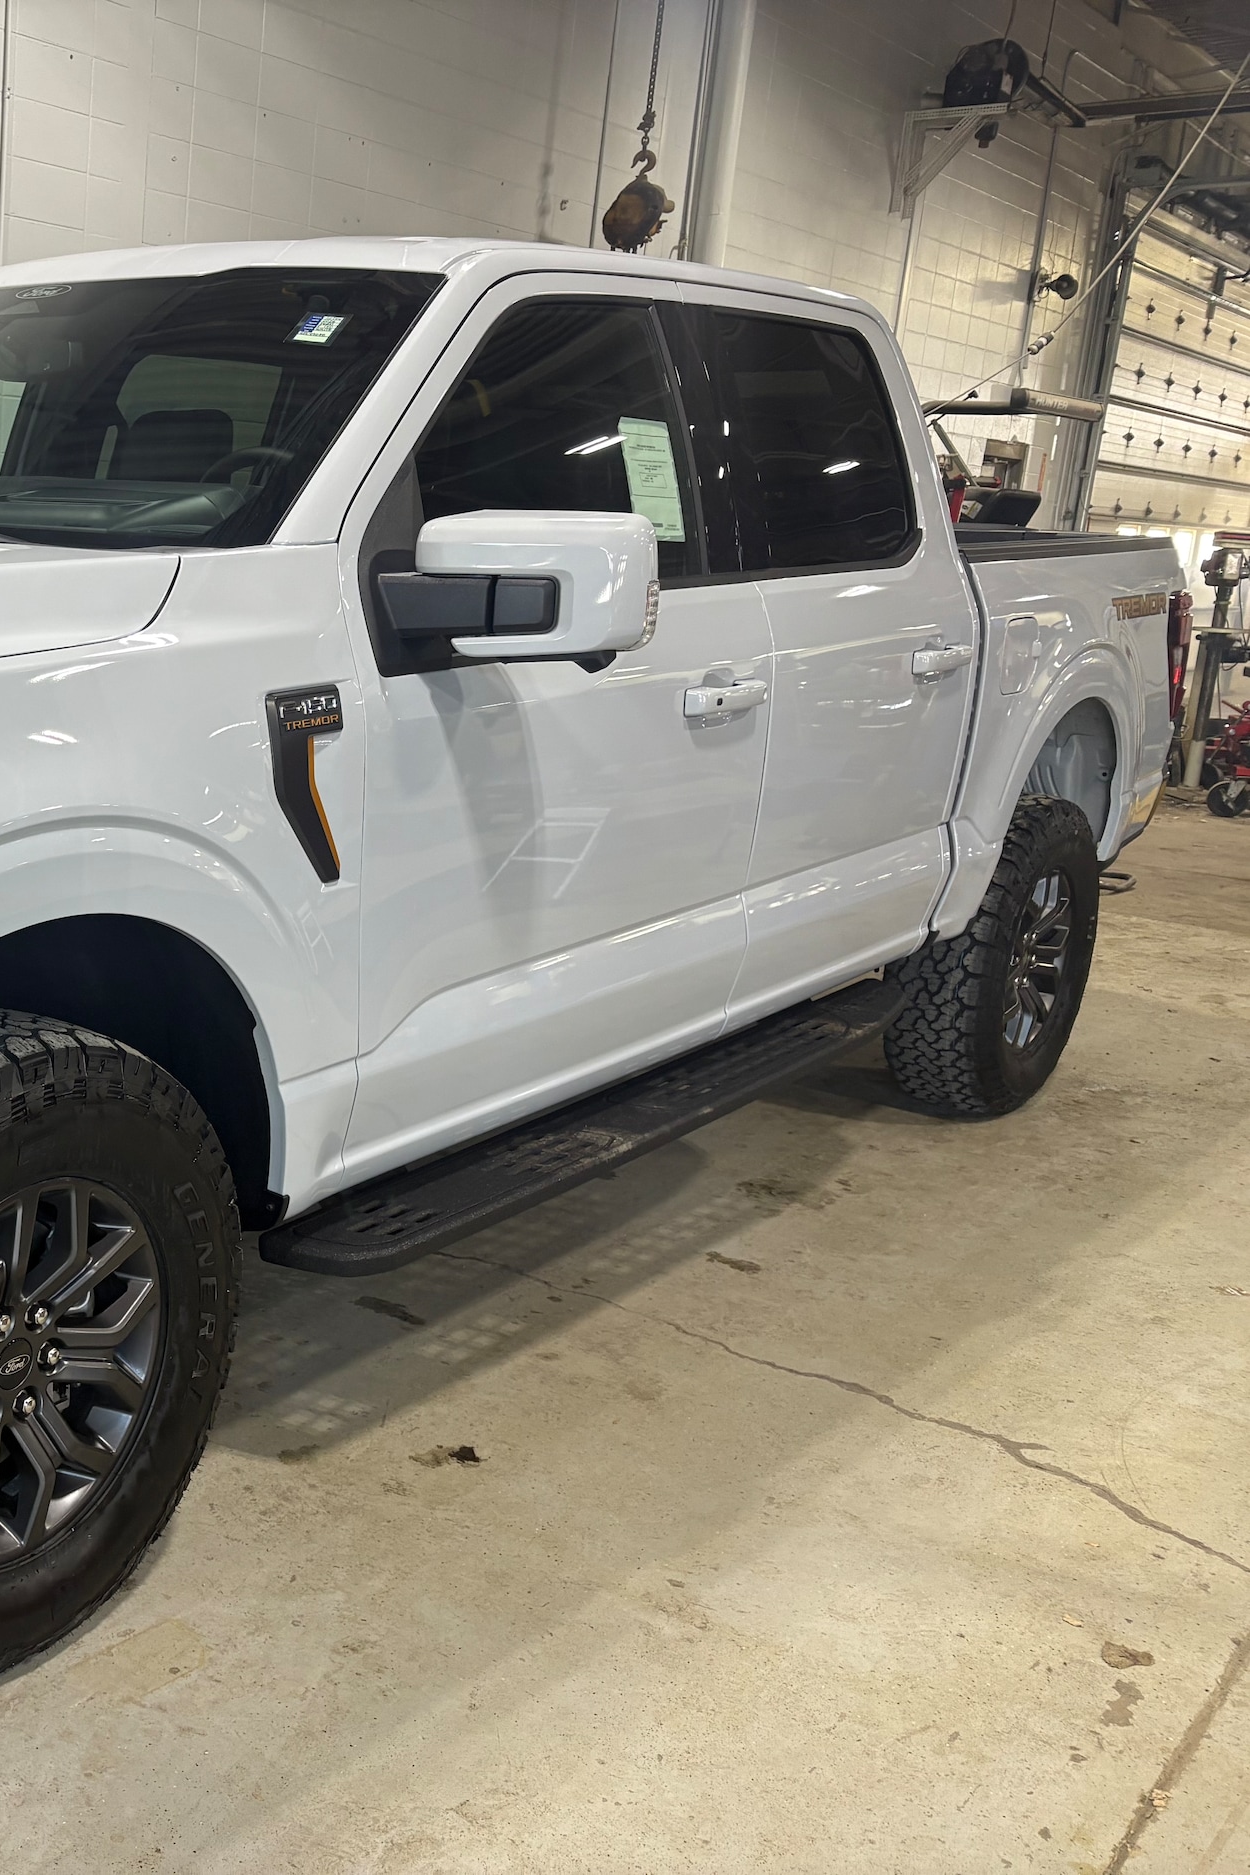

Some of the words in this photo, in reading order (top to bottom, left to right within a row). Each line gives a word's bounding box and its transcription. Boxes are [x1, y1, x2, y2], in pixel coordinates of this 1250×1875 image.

[1034, 395, 1069, 411] HUNTER
[1112, 592, 1167, 621] TREMOR
[283, 714, 339, 731] TREMOR
